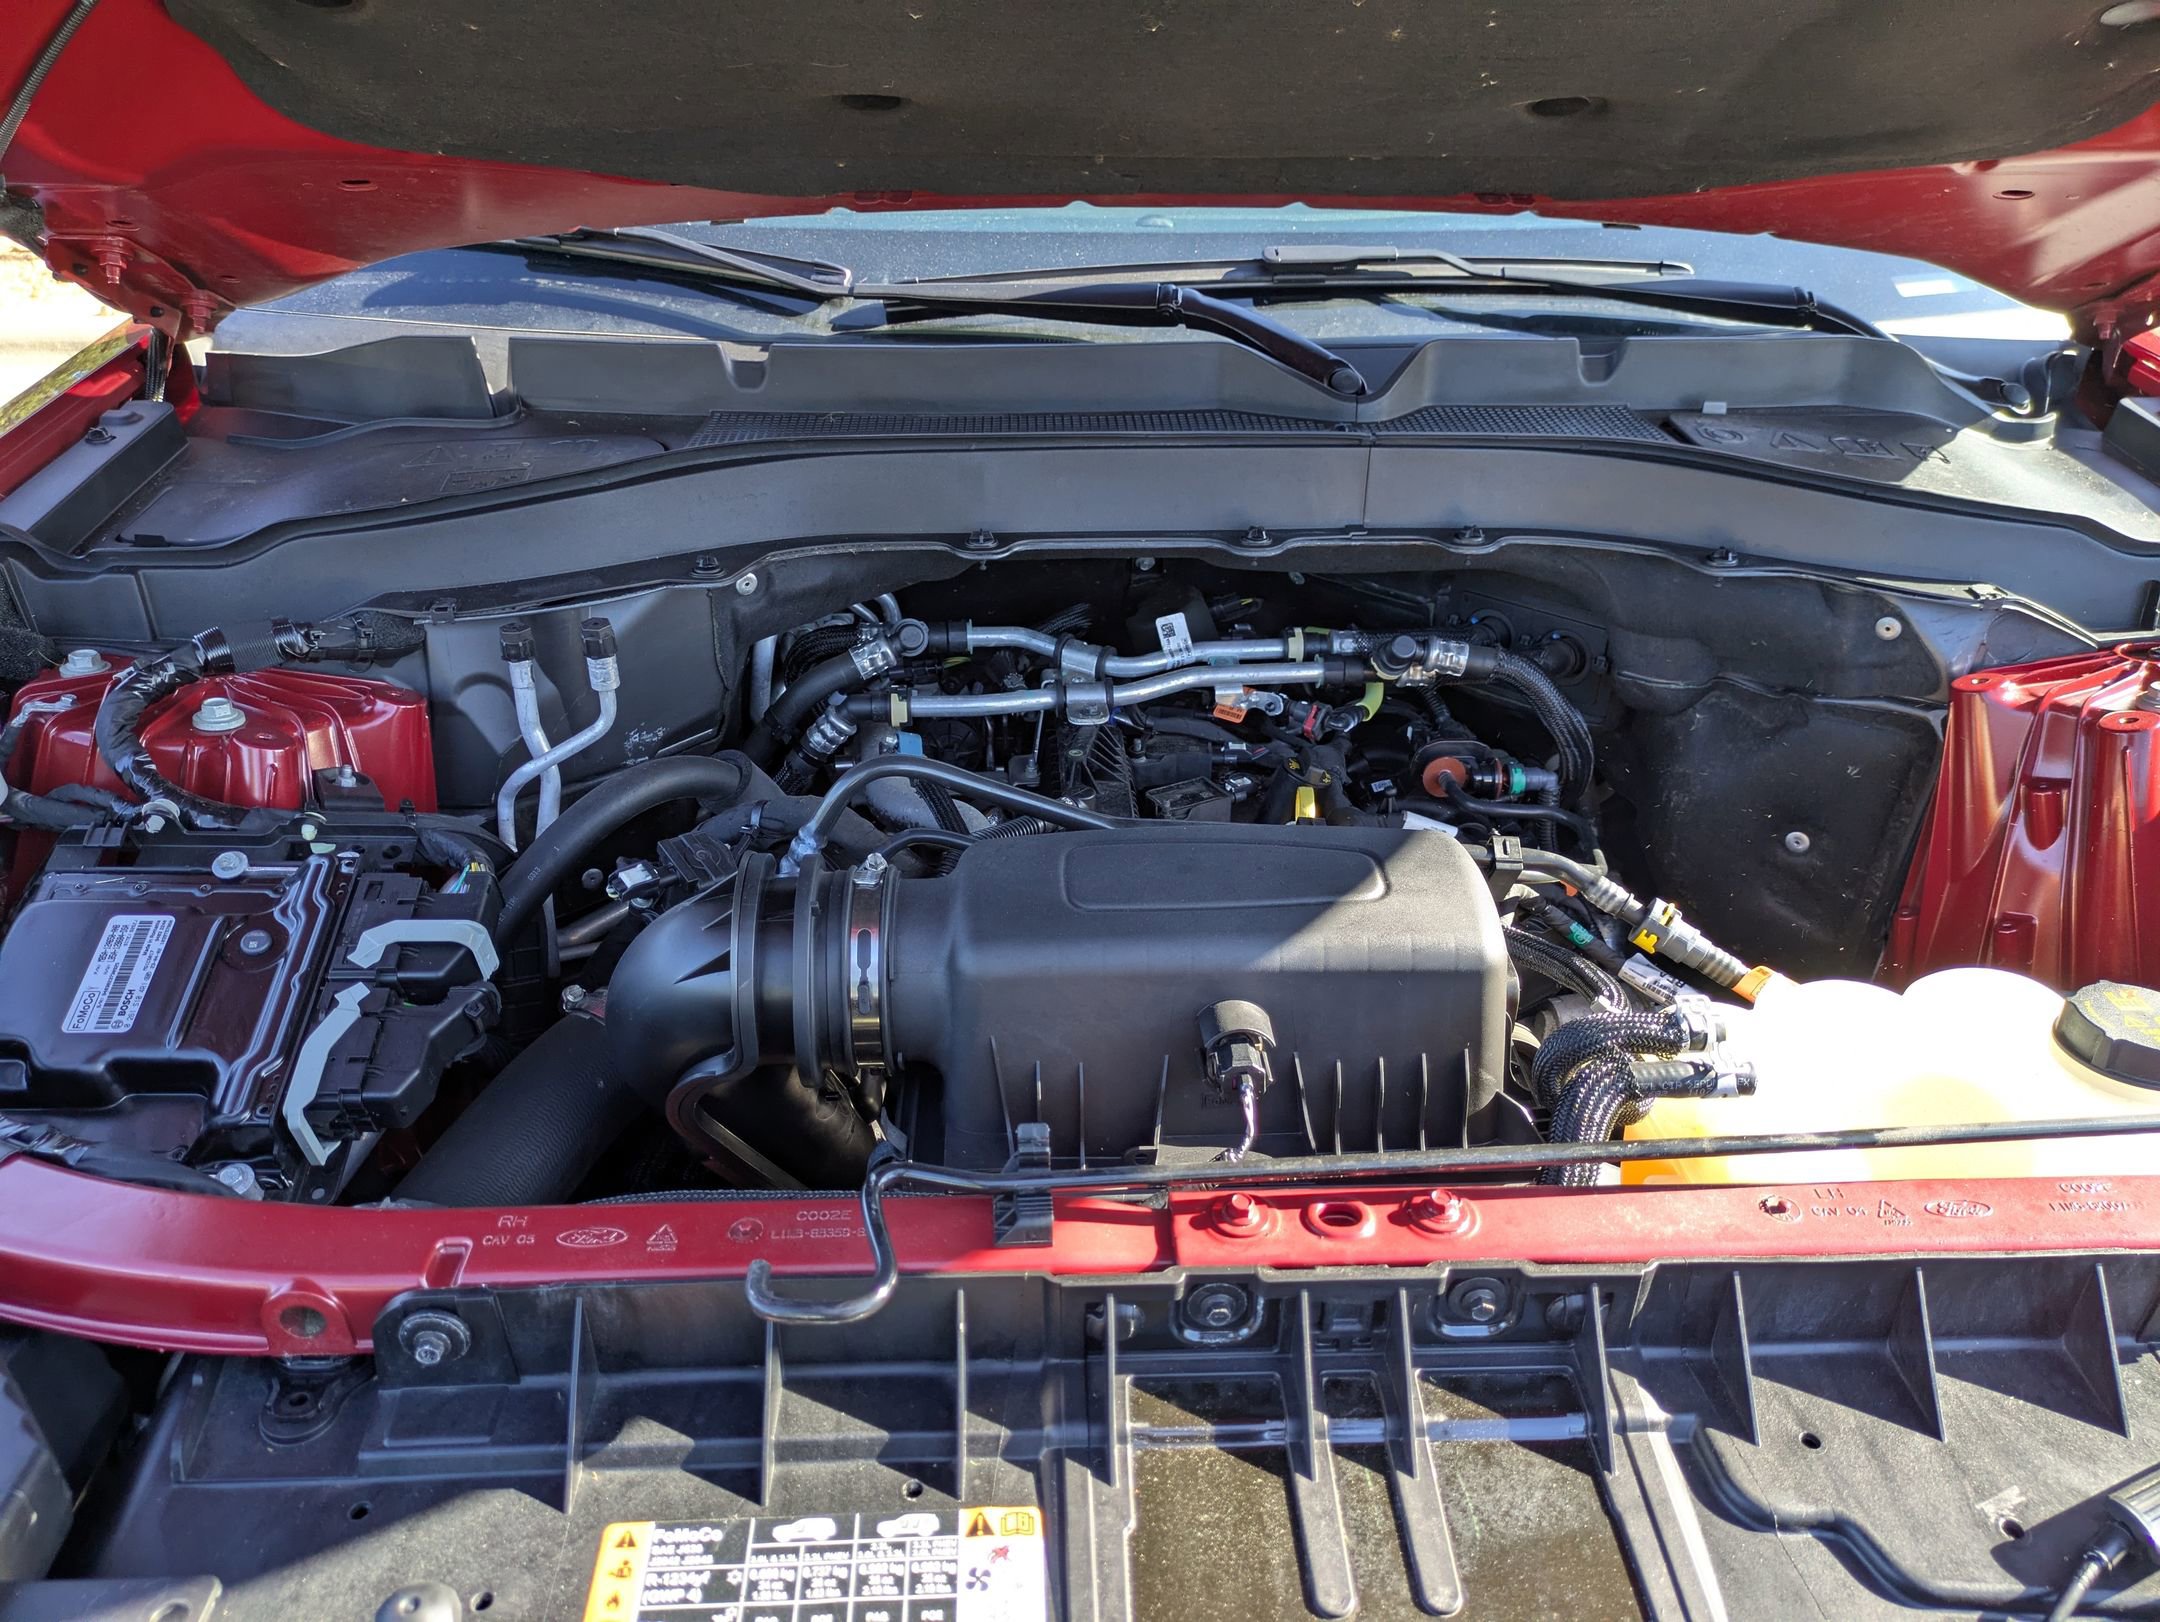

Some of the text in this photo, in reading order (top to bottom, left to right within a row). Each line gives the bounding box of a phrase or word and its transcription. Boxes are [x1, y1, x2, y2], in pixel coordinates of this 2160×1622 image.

[142, 944, 151, 956] Made
[117, 989, 136, 1017] BOSCH
[72, 992, 97, 1030] FoMoCo
[497, 1214, 528, 1229] RH
[481, 1233, 511, 1246] CAV
[652, 1527, 724, 1544] FoMoCo
[779, 1567, 796, 1582] kg
[832, 1565, 849, 1579] kg
[888, 1561, 905, 1576] kg
[941, 1560, 958, 1575] kg
[645, 1570, 711, 1588] R-1234yf
[921, 1609, 944, 1621] POE
